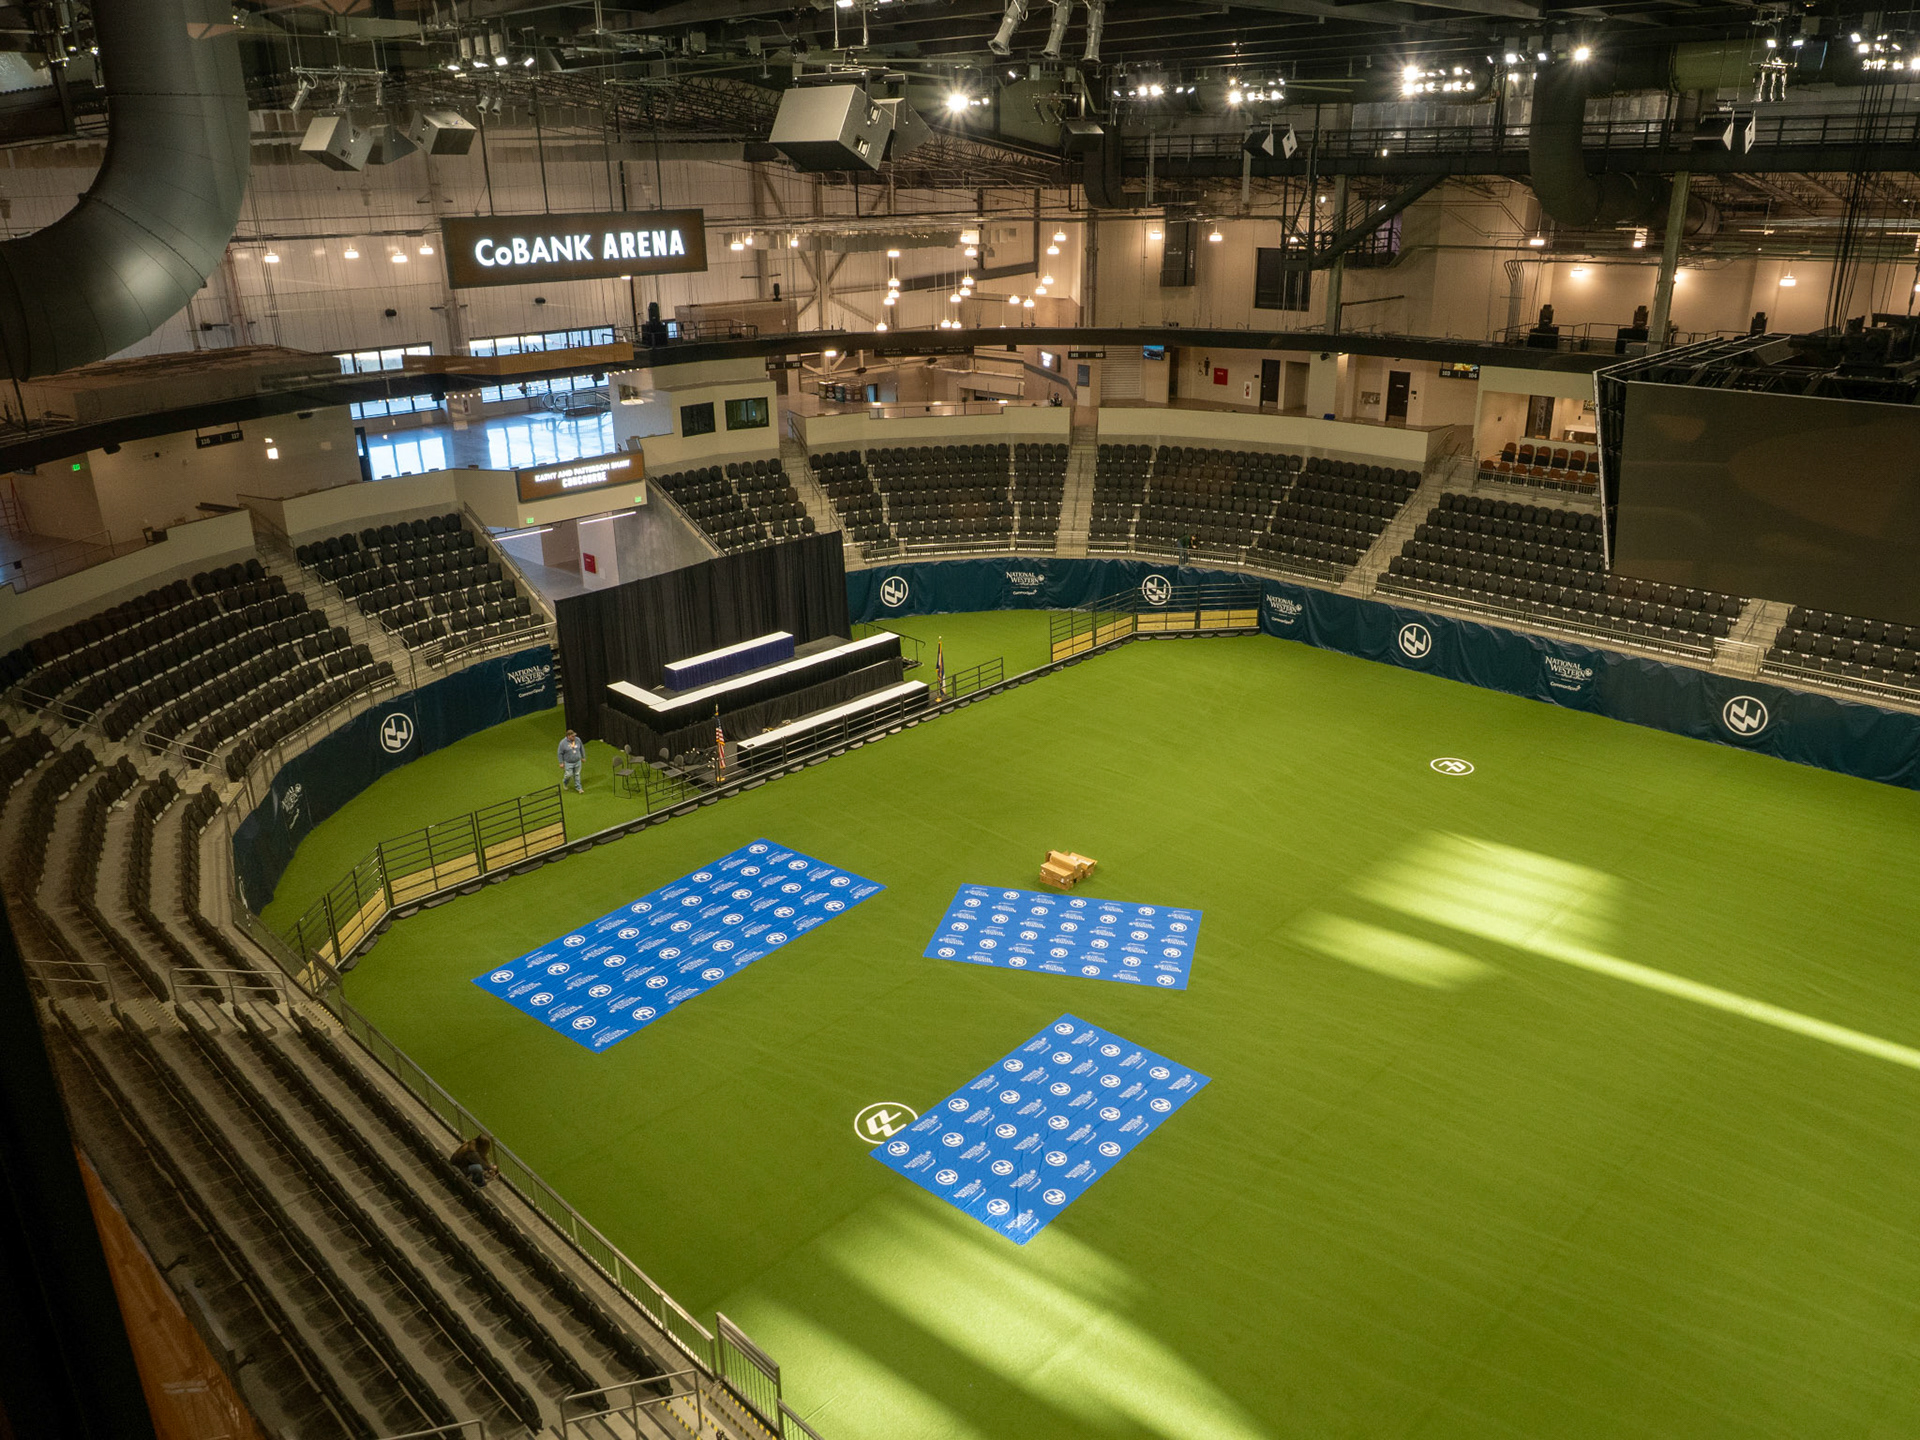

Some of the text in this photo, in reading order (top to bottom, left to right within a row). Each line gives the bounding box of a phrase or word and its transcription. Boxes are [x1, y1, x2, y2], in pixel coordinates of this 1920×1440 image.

[474, 229, 685, 267] CoBANK ARENA
[557, 468, 574, 479] AND
[562, 471, 607, 488] CONCOURSE
[1545, 655, 1582, 670] NATIONAL
[507, 665, 541, 680] NATIONAL
[513, 671, 545, 684] WESTERN
[1550, 664, 1585, 678] WESTERN
